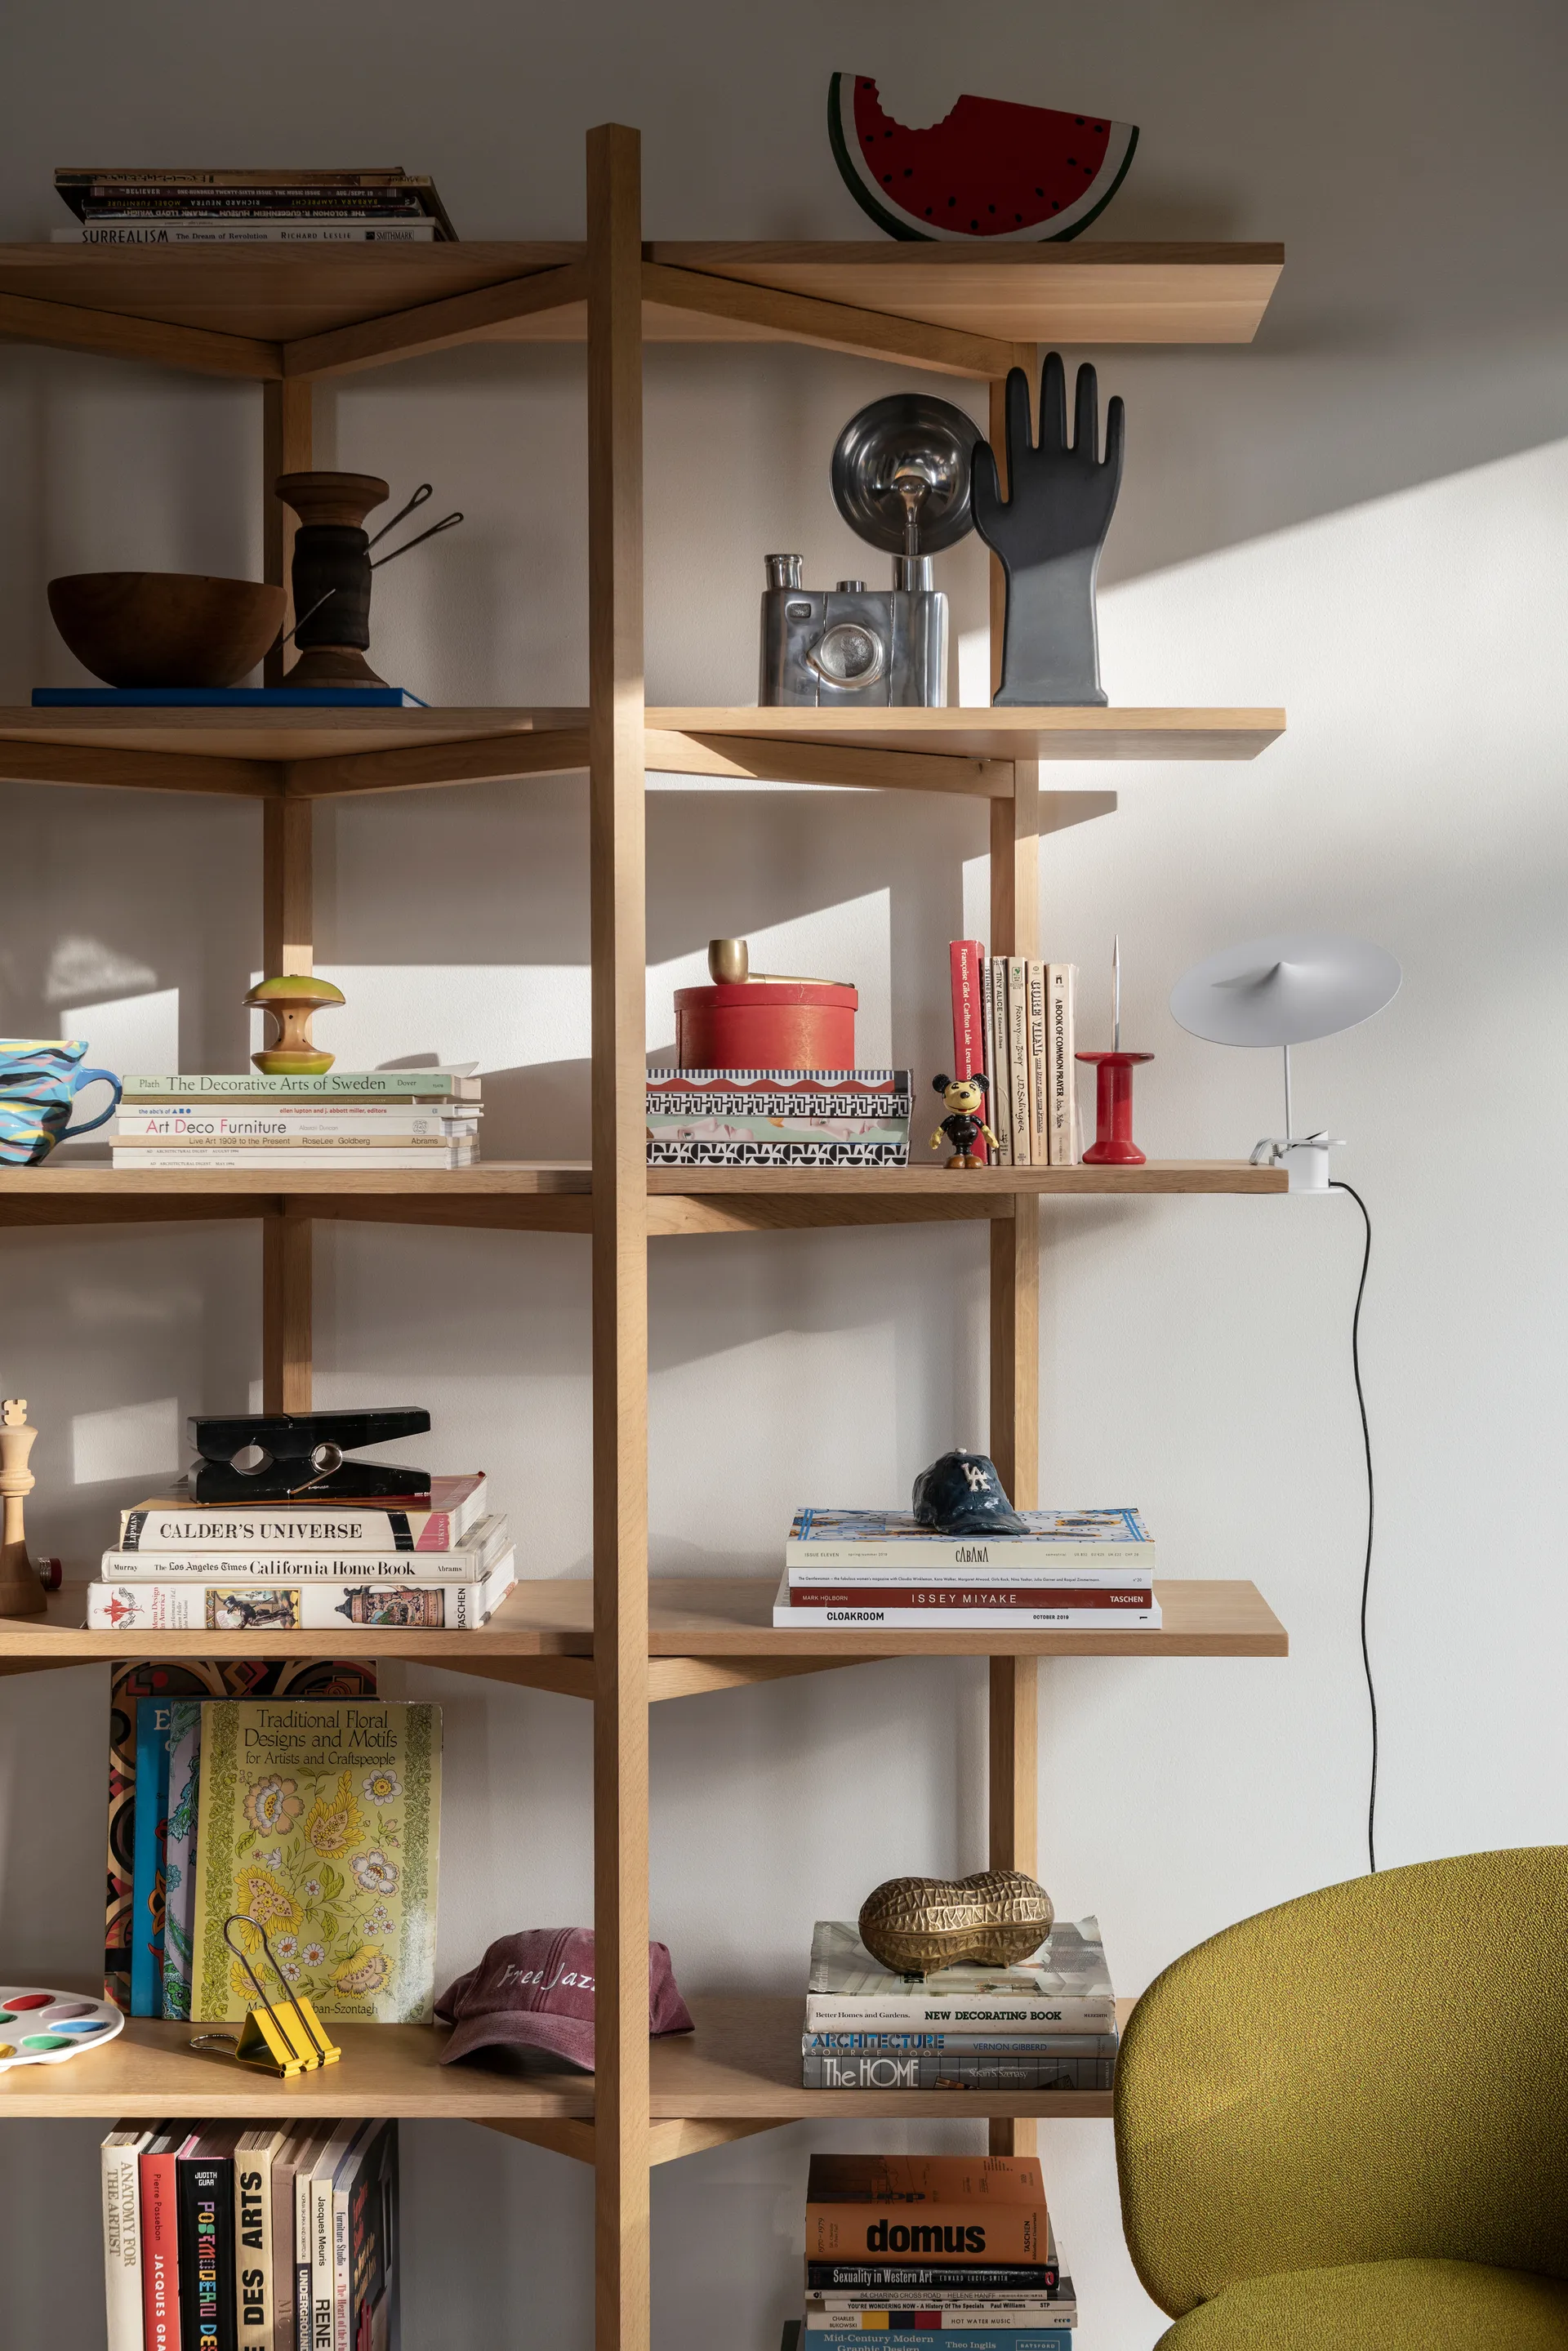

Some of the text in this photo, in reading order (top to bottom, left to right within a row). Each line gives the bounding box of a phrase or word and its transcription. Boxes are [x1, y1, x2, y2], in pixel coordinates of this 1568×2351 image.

[82, 229, 168, 243] SURREALISM
[376, 231, 413, 241] SMITHMARK
[1031, 979, 1043, 1016] GORE
[1032, 1017, 1044, 1056] VIDAL
[1055, 1004, 1064, 1097] BOOK COMMON PRAYER
[139, 1079, 160, 1088] Plath
[166, 1076, 195, 1091] The
[201, 1076, 279, 1091] Decorative
[280, 1076, 310, 1091] Arts
[314, 1075, 328, 1091] of
[332, 1075, 386, 1091] Sweden
[145, 1119, 287, 1133] Art Deco Furniture
[337, 1137, 371, 1146] Goldberg
[130, 1514, 363, 1543] LIPMAN CALDER'S UNIVERSE
[956, 1546, 989, 1563] CABANA
[114, 1564, 138, 1573] Murray
[168, 1561, 185, 1571] Los
[185, 1561, 219, 1573] Angeles
[220, 1561, 247, 1571] Times
[250, 1561, 327, 1575] California
[333, 1561, 375, 1575] Home
[378, 1561, 416, 1575] Book
[151, 1587, 160, 1610] Design
[457, 1587, 466, 1629] TASCHEN
[911, 1594, 1017, 1603] ISSEY MIYAKE
[826, 1612, 884, 1621] CLOAKROOM
[256, 1708, 388, 1729] Traditional Floral
[243, 1728, 398, 1751] Designs and Motifs
[245, 1751, 395, 1768] for Artists and Craftspeople
[497, 1963, 544, 1988] Free
[924, 2010, 951, 2020] NEW
[955, 2010, 1027, 2020] DECORATING
[1030, 2010, 1062, 2020] BOOK
[811, 2033, 944, 2049] ARCHITECTURE
[973, 2042, 1009, 2050] VERNON
[811, 2049, 881, 2057] SOURCE
[823, 2059, 919, 2087] The HOME
[998, 2069, 1028, 2080] Szenasy
[107, 2169, 122, 2257] THE ARTIST
[120, 2161, 136, 2268] ANATOMY FOR
[154, 2174, 162, 2241] Pierre Passebon
[240, 2171, 263, 2251] ARTS
[317, 2197, 327, 2267] Jacques Meuris
[866, 2219, 986, 2254] domus
[197, 2201, 217, 2317] POSTMODERN
[336, 2212, 347, 2319] Furniture Studio The Heart
[154, 2254, 167, 2317] JACQUES
[833, 2269, 873, 2286] Sexuality
[874, 2269, 882, 2283] in
[884, 2269, 917, 2284] Western
[919, 2269, 933, 2283] Art
[242, 2269, 265, 2326] DES
[823, 2334, 934, 2345] Mid-Century Modern
[970, 2341, 996, 2351] Inglis
